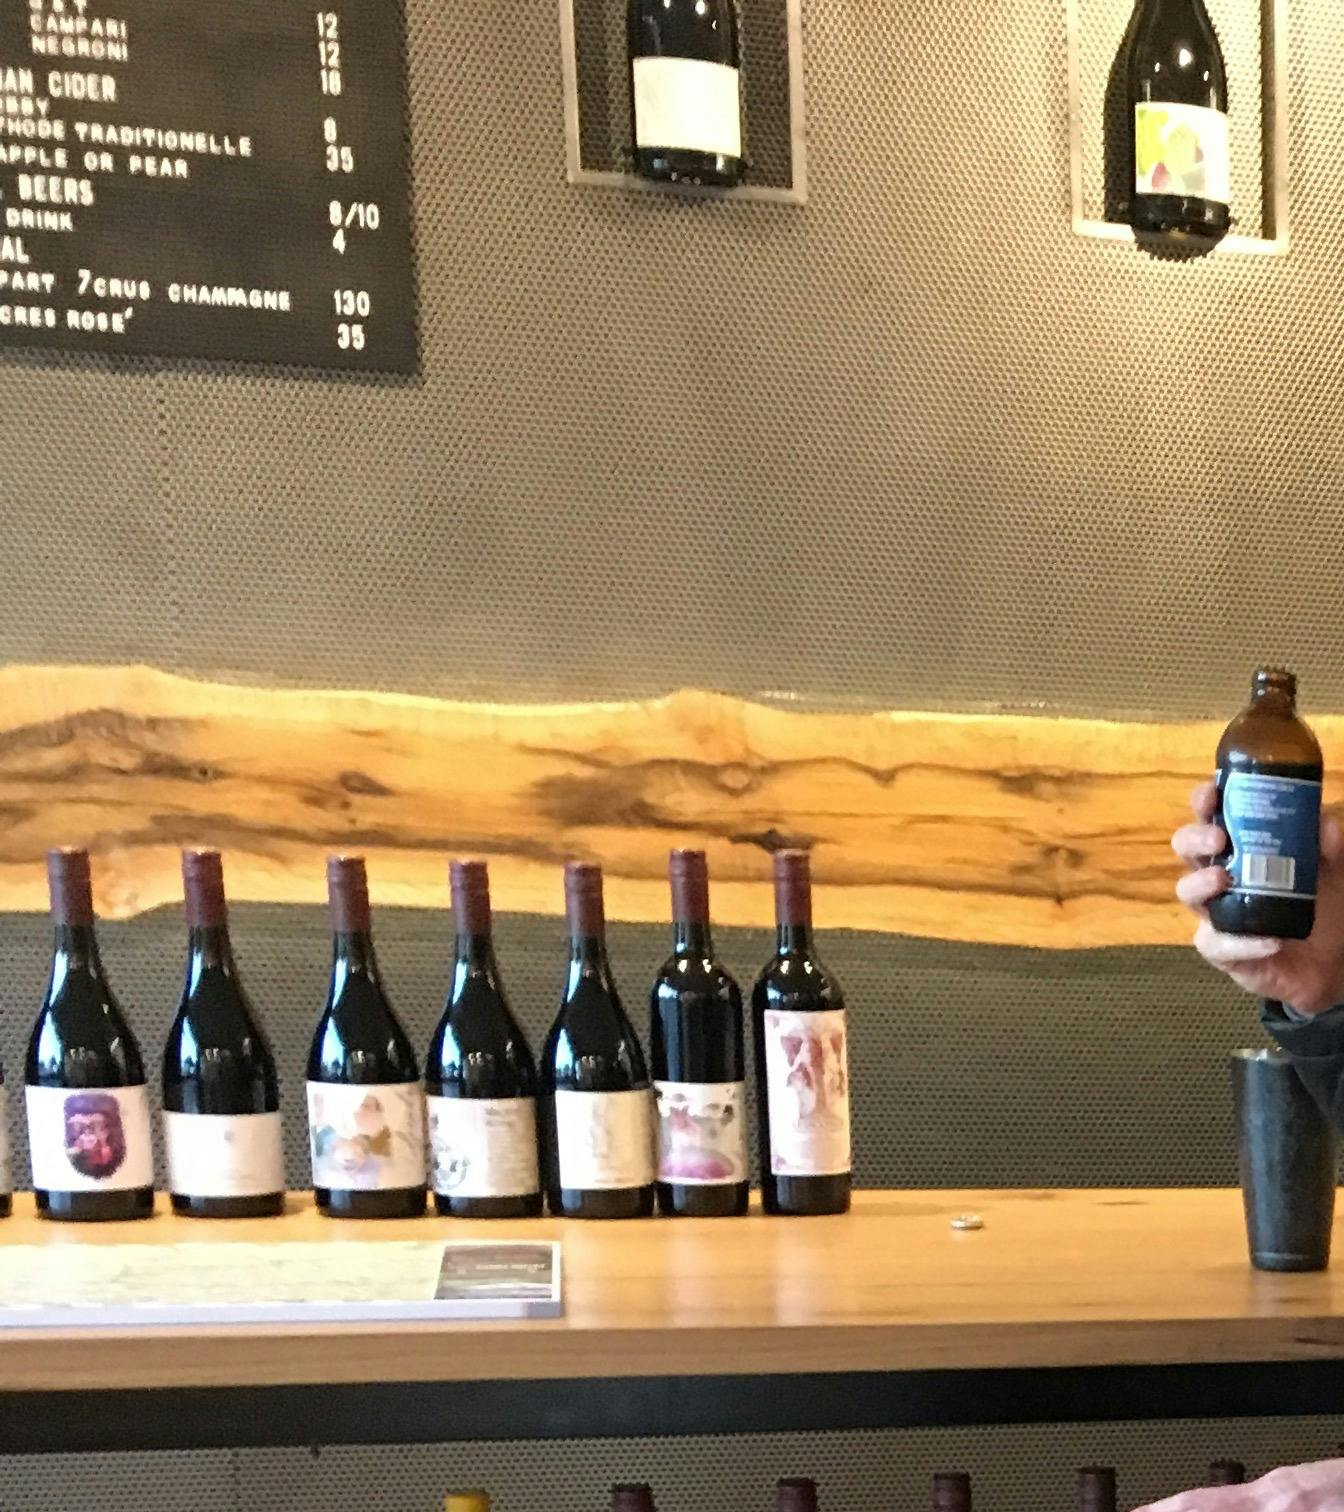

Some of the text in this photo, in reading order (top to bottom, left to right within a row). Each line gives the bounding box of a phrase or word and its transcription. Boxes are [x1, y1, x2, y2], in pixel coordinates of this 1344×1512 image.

[30, 12, 127, 39] CAMPARI
[317, 12, 339, 39] 12
[31, 34, 128, 61] NEGRONI
[318, 40, 341, 68] 12
[48, 70, 117, 102] CIDER
[74, 121, 253, 158] TRADITIONELLE
[83, 150, 115, 173] OR
[129, 154, 189, 179] PEAR
[326, 144, 354, 173] 35
[6, 207, 73, 232] DRINK
[333, 228, 347, 255] 4
[168, 282, 291, 312] CHAMPAGNE
[333, 288, 371, 317] 130
[337, 323, 366, 351] 35
